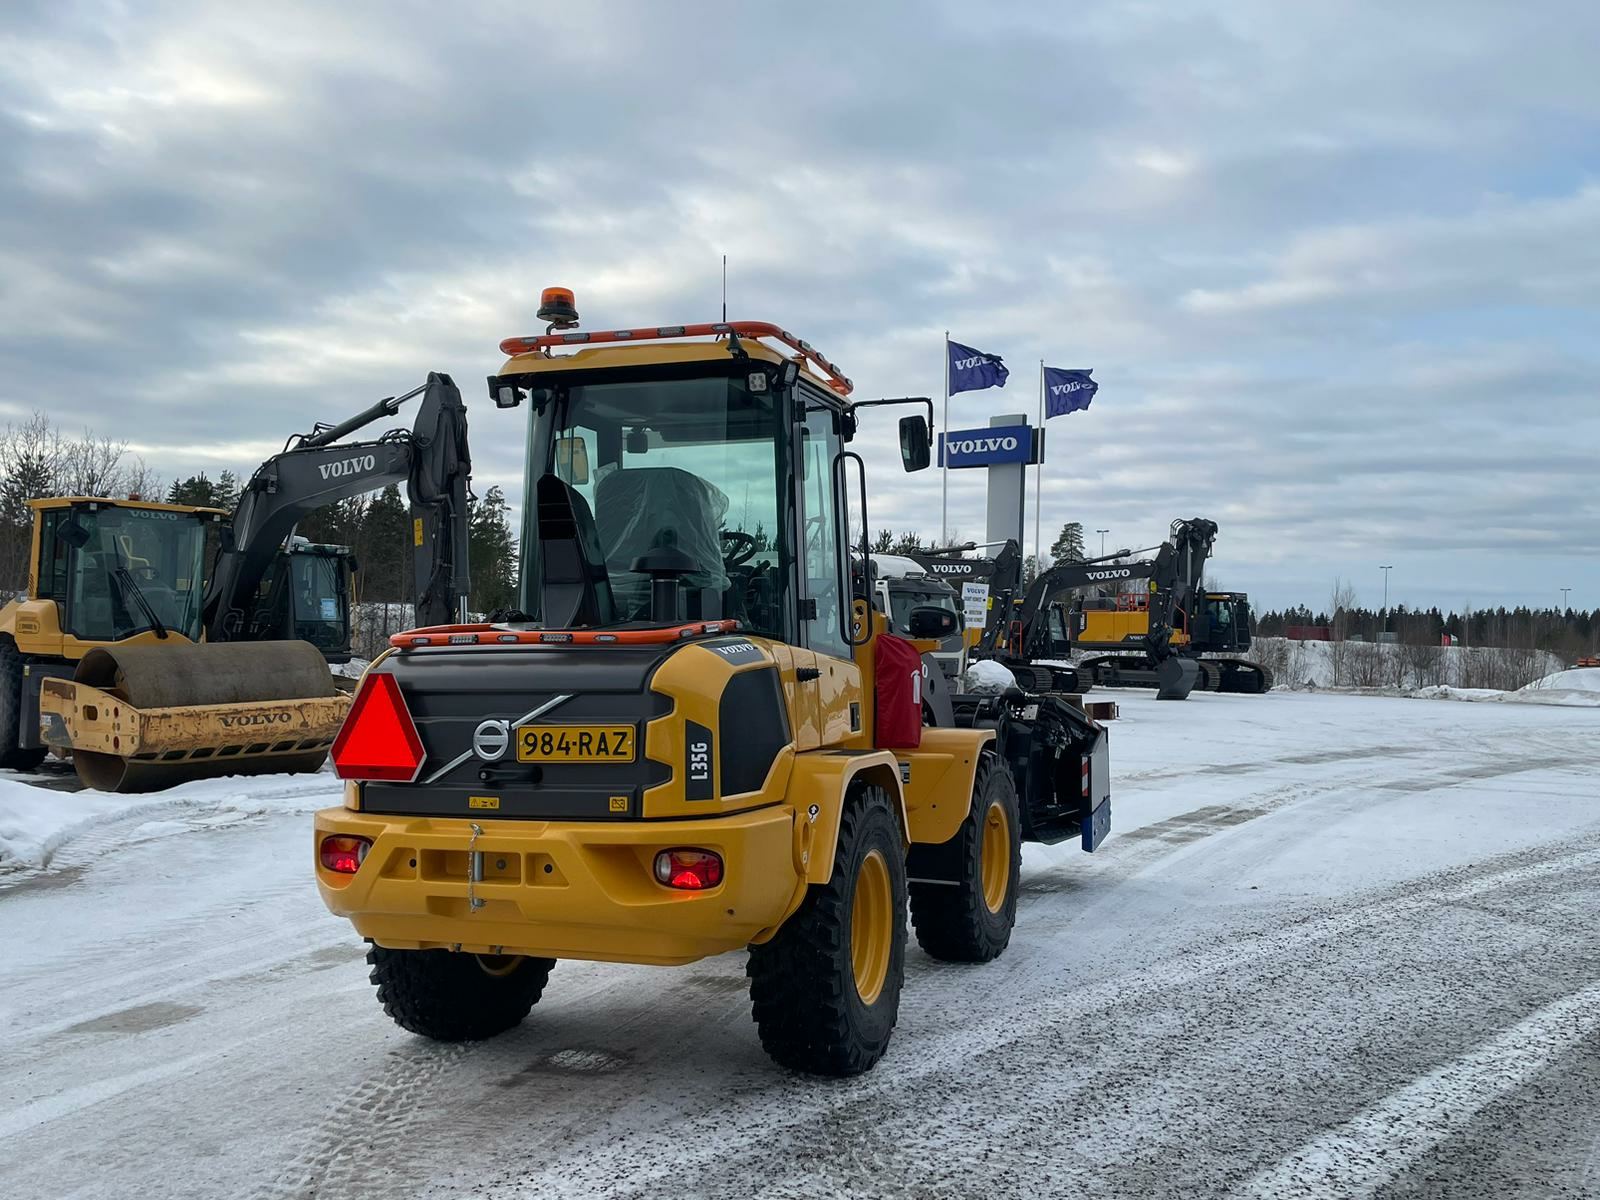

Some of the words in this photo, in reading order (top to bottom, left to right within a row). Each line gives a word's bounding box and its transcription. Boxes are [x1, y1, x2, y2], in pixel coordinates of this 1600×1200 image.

[1051, 381, 1093, 396] VOLVO
[946, 437, 1018, 454] VOLVO
[318, 454, 376, 480] VOLVO
[128, 509, 178, 521] VOLVO
[931, 564, 972, 574] VOLVO
[1086, 568, 1131, 580] VOLVO
[717, 643, 754, 655] VOLVO
[218, 712, 292, 727] VOLVO
[523, 731, 628, 756] 984-RAZ
[691, 742, 708, 780] L35G
